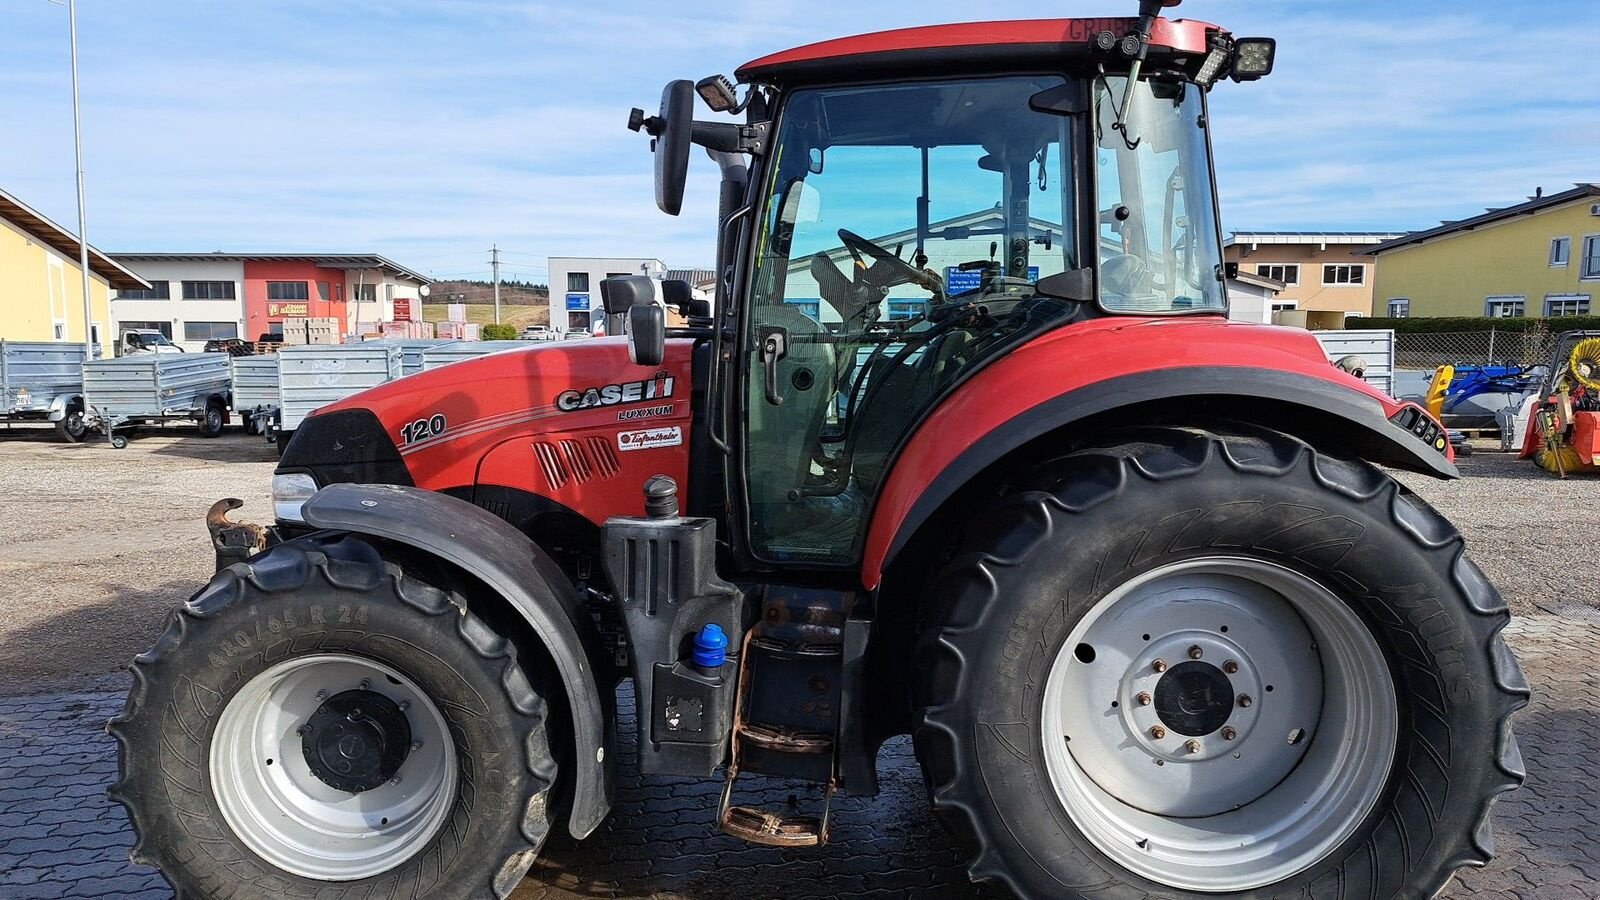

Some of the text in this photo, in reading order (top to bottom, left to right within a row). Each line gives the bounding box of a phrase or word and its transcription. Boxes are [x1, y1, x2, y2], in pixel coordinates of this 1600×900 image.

[557, 382, 642, 410] CASE
[617, 404, 674, 421] LUXXUM
[400, 413, 447, 446] 120
[309, 604, 327, 625] R
[337, 603, 369, 625] 24
